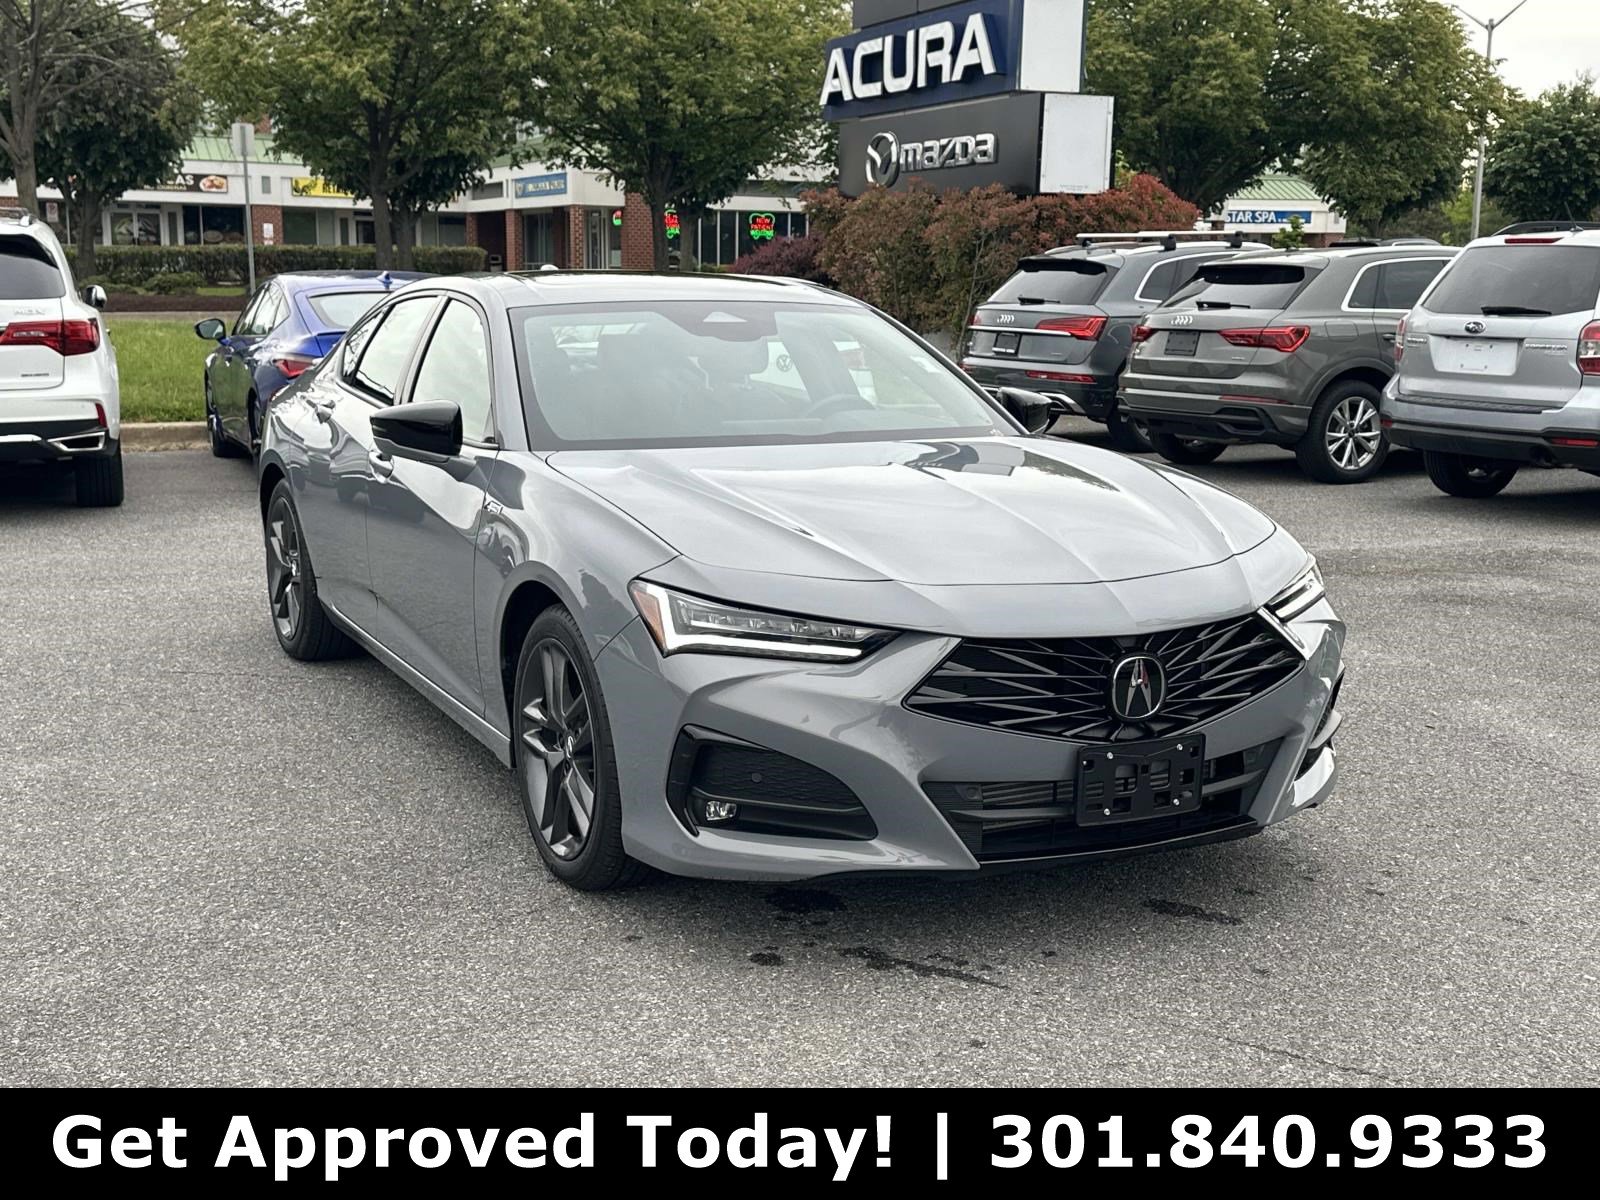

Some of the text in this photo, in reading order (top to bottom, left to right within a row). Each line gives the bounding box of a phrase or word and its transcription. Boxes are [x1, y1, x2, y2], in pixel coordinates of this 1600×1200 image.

[819, 12, 997, 106] ACURA
[1225, 211, 1277, 222] STAR SPA
